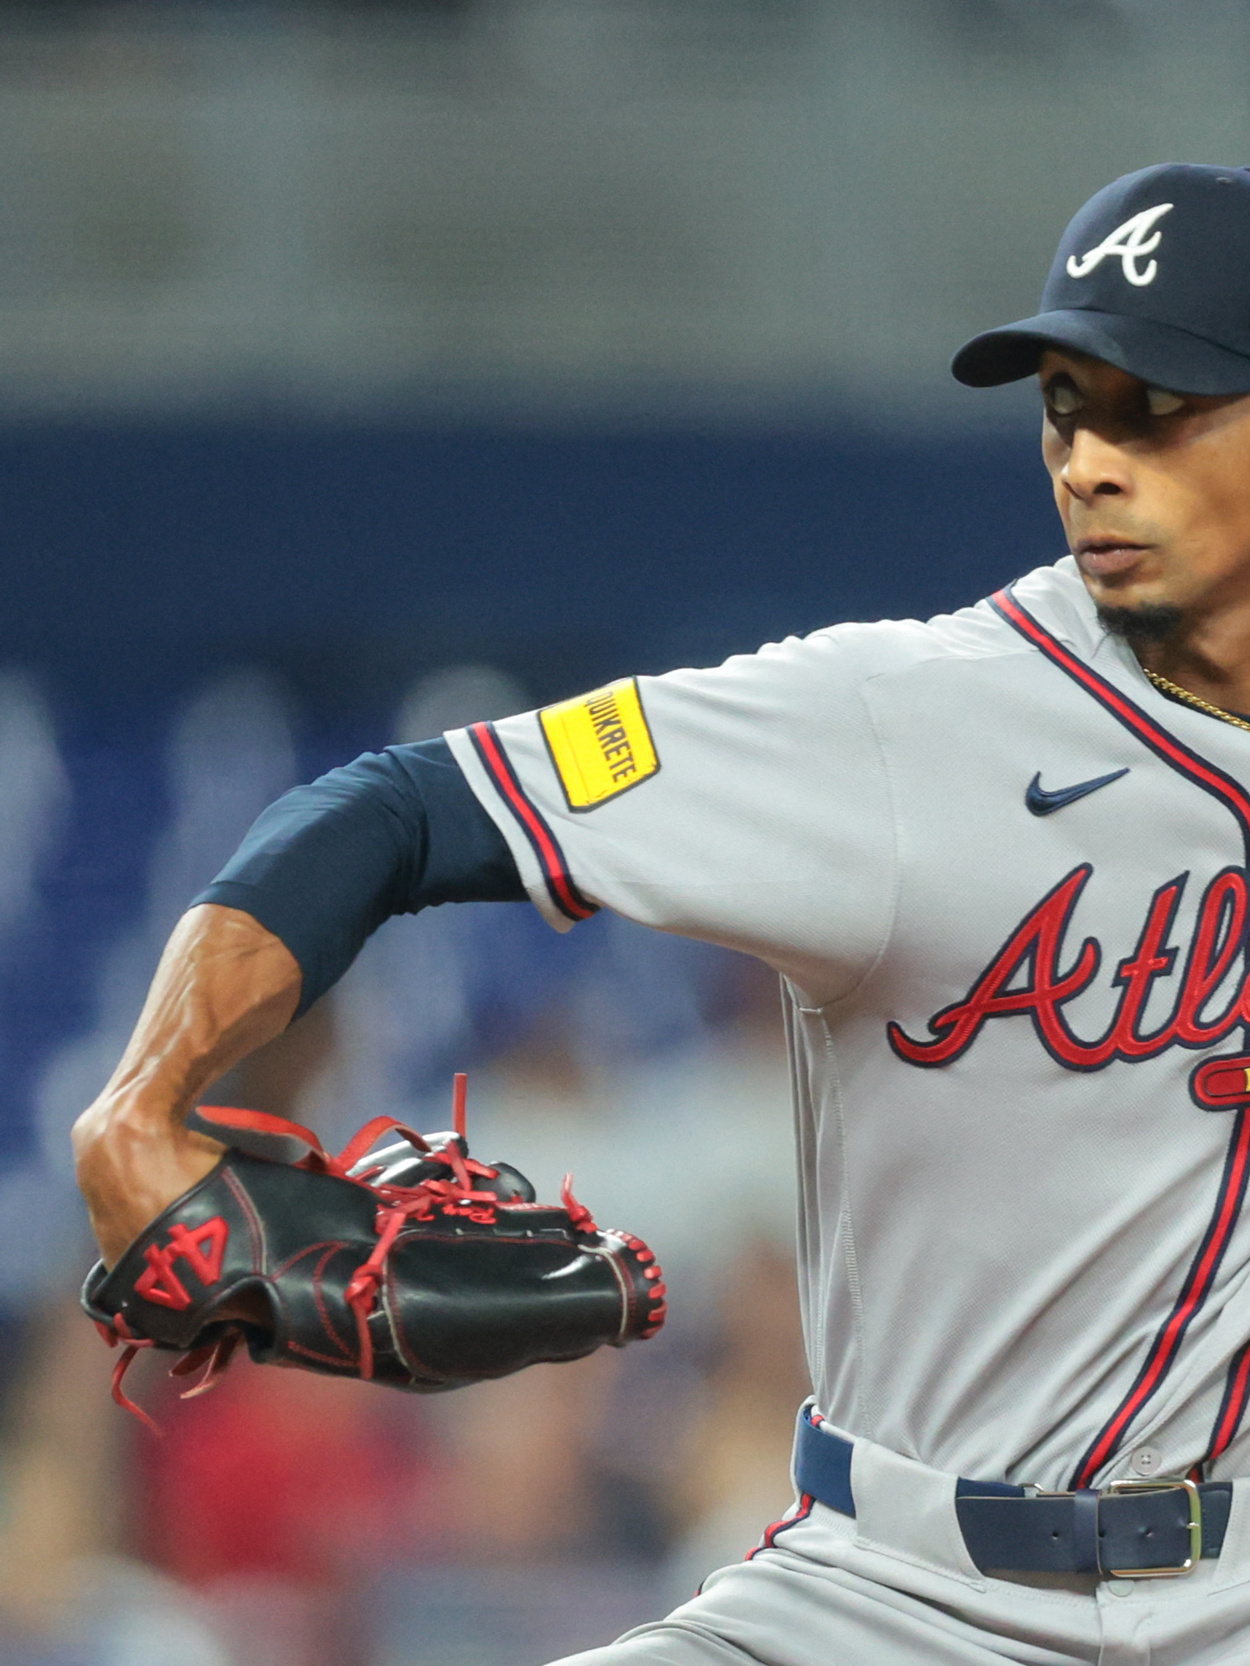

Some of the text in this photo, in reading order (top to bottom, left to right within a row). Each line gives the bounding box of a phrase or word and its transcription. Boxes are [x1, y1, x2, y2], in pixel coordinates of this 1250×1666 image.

[1066, 202, 1174, 287] A
[583, 690, 638, 784] QUIKRETE
[133, 1215, 230, 1311] 44
